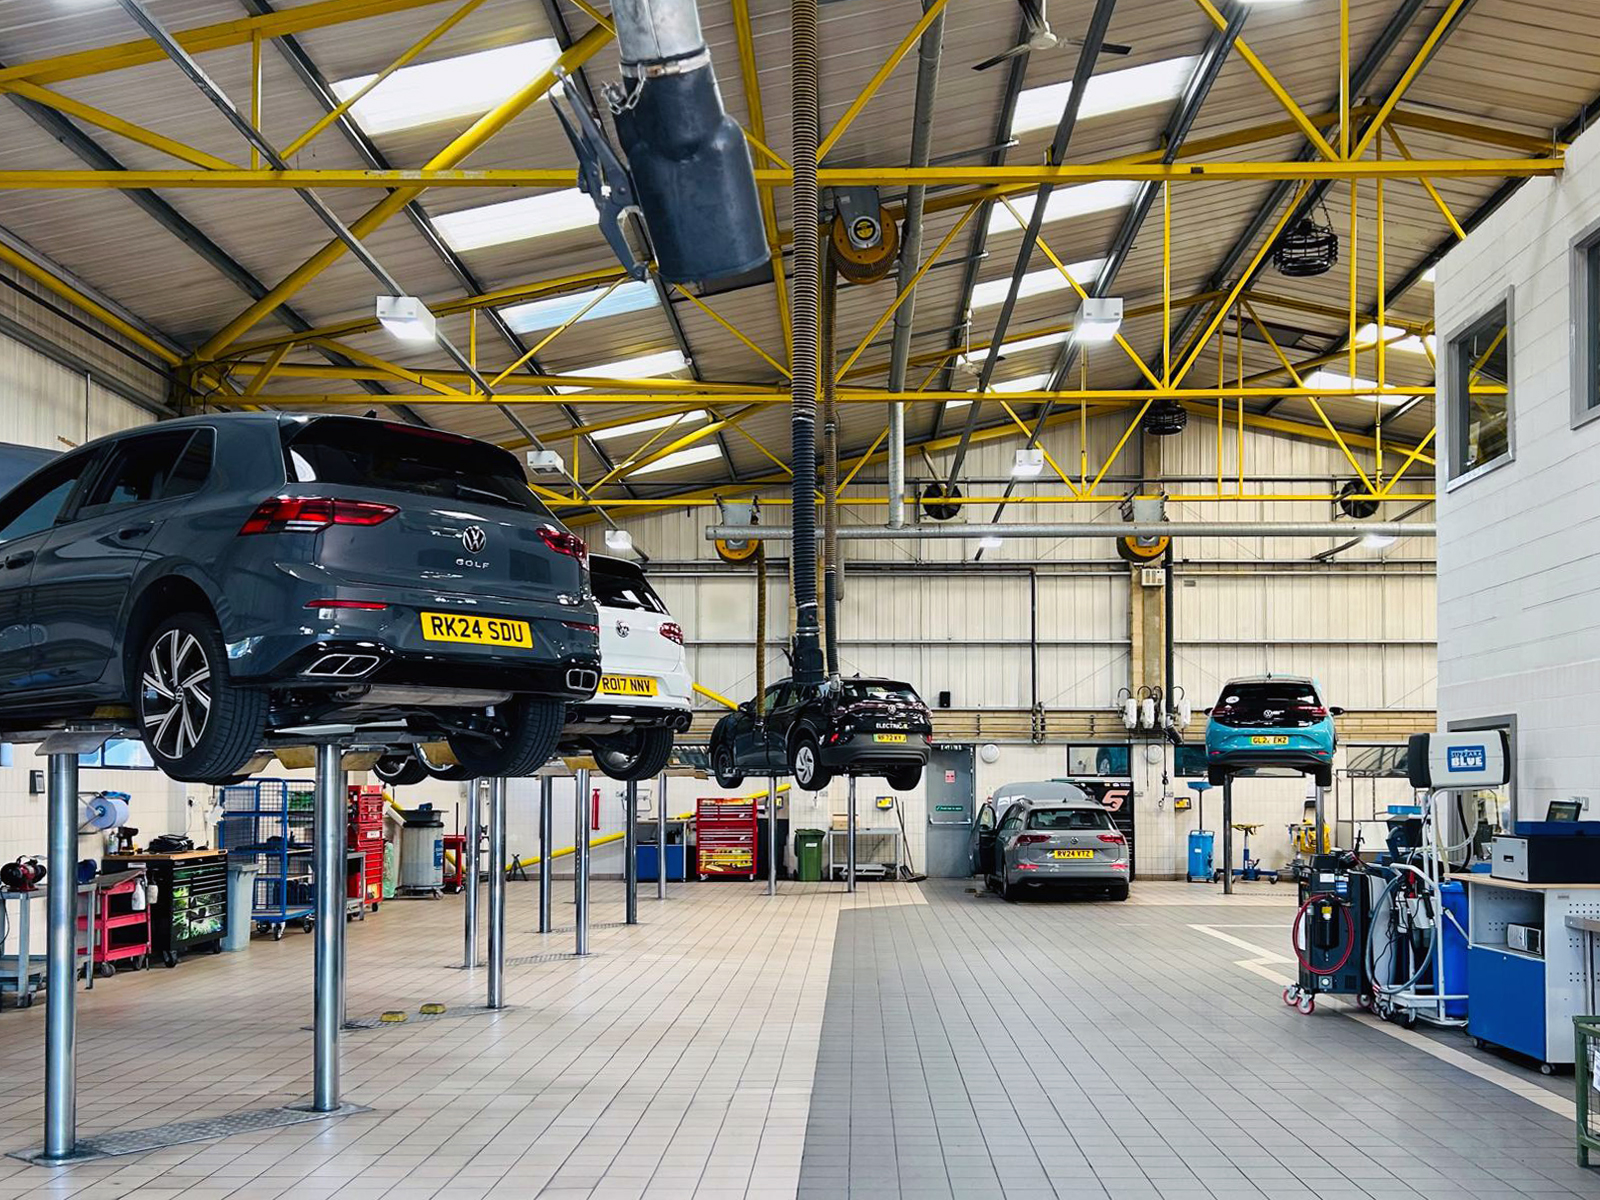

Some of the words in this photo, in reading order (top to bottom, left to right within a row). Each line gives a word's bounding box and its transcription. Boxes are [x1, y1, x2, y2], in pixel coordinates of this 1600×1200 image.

[455, 558, 490, 569] GOLF
[430, 615, 483, 639] RK24
[489, 621, 524, 643] SDU
[602, 677, 627, 691] RO17
[630, 679, 650, 692] NNV
[1451, 757, 1482, 767] BLUE
[1057, 850, 1075, 858] RV24
